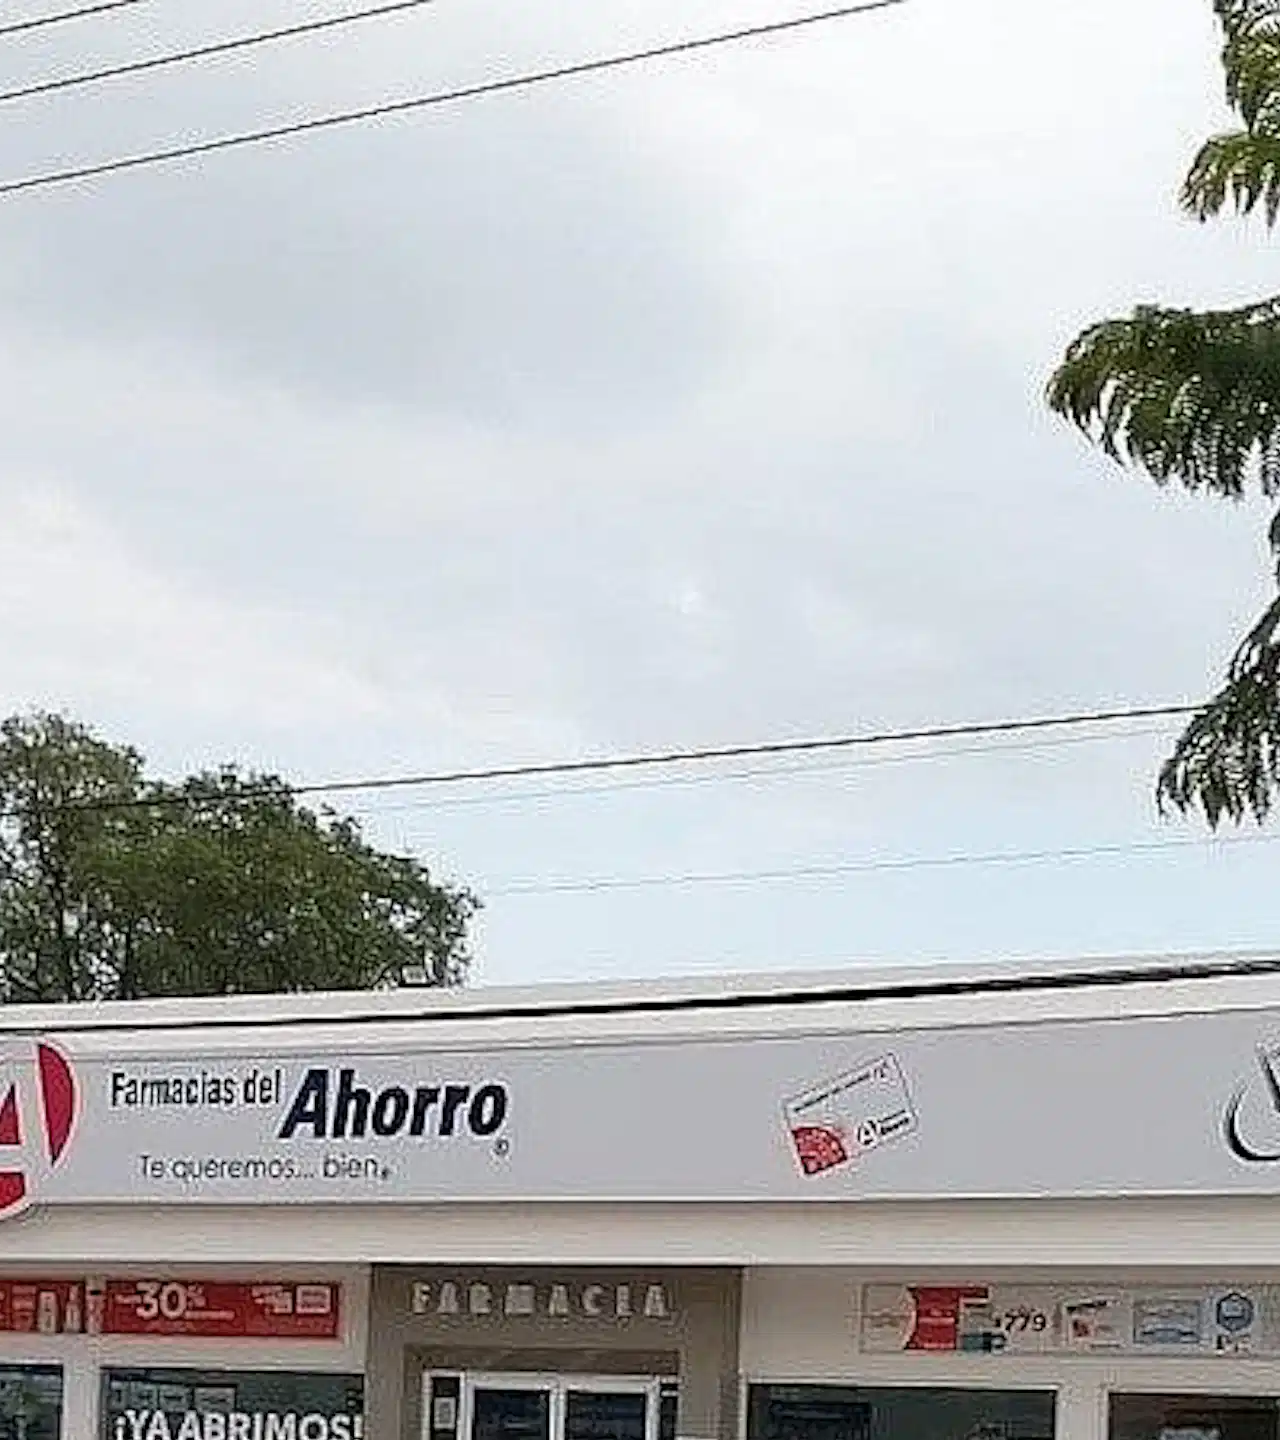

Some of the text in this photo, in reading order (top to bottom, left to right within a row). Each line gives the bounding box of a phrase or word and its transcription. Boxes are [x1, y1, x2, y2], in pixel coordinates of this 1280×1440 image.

[111, 1068, 508, 1139] Farmacias del Ahorro
[139, 1154, 165, 1177] Te
[411, 1280, 670, 1318] FARMACIA
